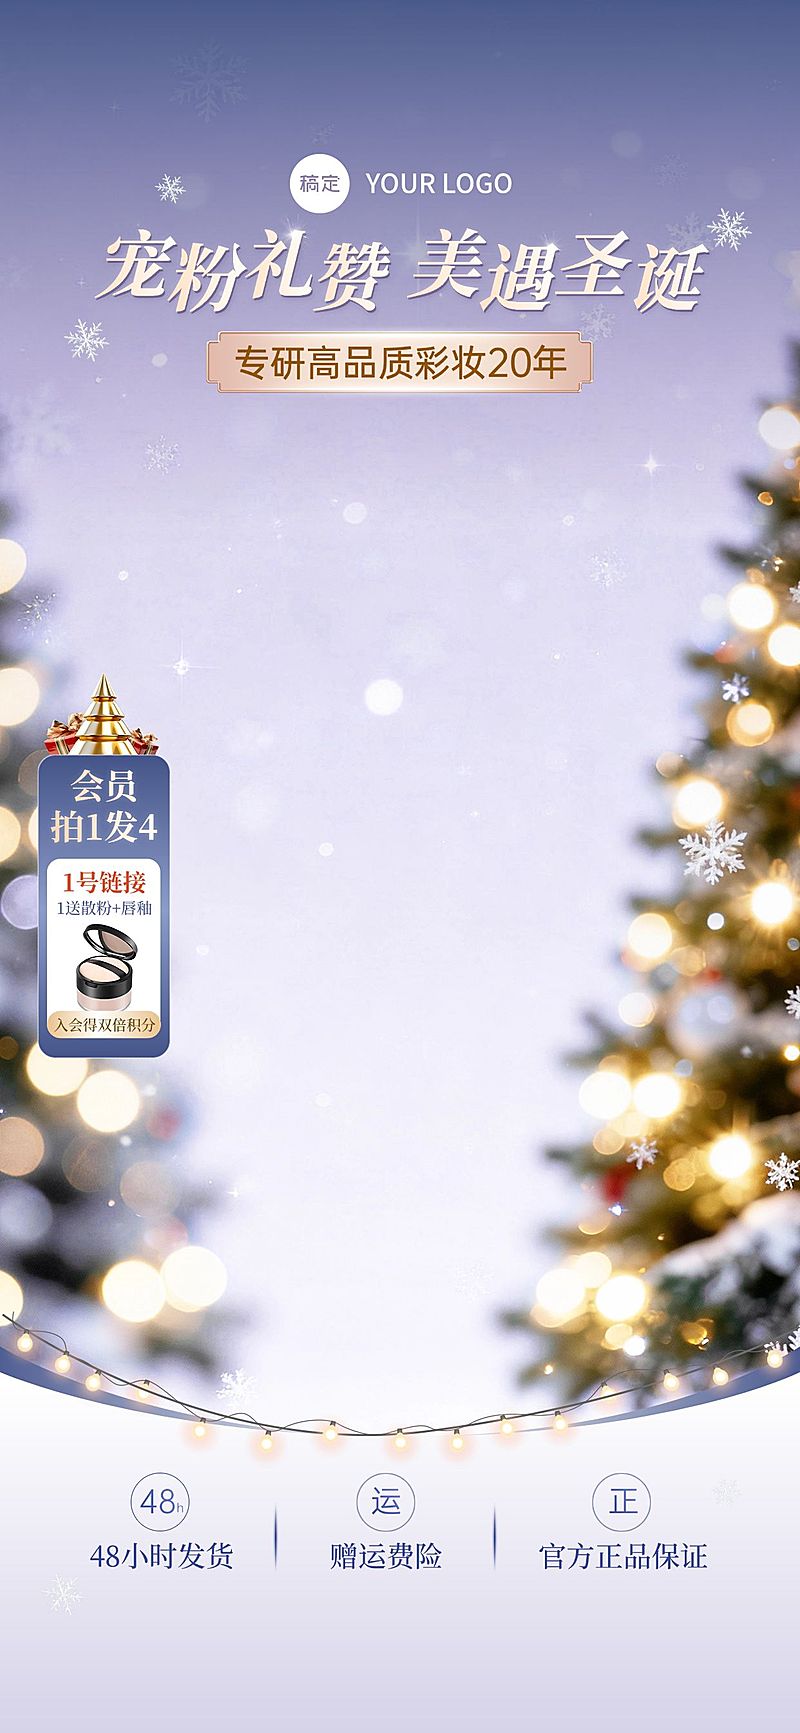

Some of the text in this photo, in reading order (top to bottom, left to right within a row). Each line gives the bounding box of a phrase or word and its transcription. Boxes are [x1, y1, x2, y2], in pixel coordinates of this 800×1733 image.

[300, 174, 340, 193] 稿定
[365, 173, 513, 195] YOUR LOGO
[95, 228, 709, 314] 宠粉礼赞 美遇圣诞
[235, 344, 568, 381] 专研高品质彩妆20年
[70, 769, 137, 803] 会员
[51, 810, 158, 844] 拍1发4
[63, 871, 146, 895] 1号链接
[57, 901, 152, 916] 1送散粉+唇釉
[54, 1017, 156, 1033] 入会得双倍积分
[139, 1488, 184, 1515] 48h
[371, 1487, 401, 1516] 运
[609, 1488, 639, 1515] 正
[90, 1542, 234, 1571] 48小时发货
[330, 1542, 442, 1571] 赠运费险
[539, 1542, 708, 1571] 官方正品保证
